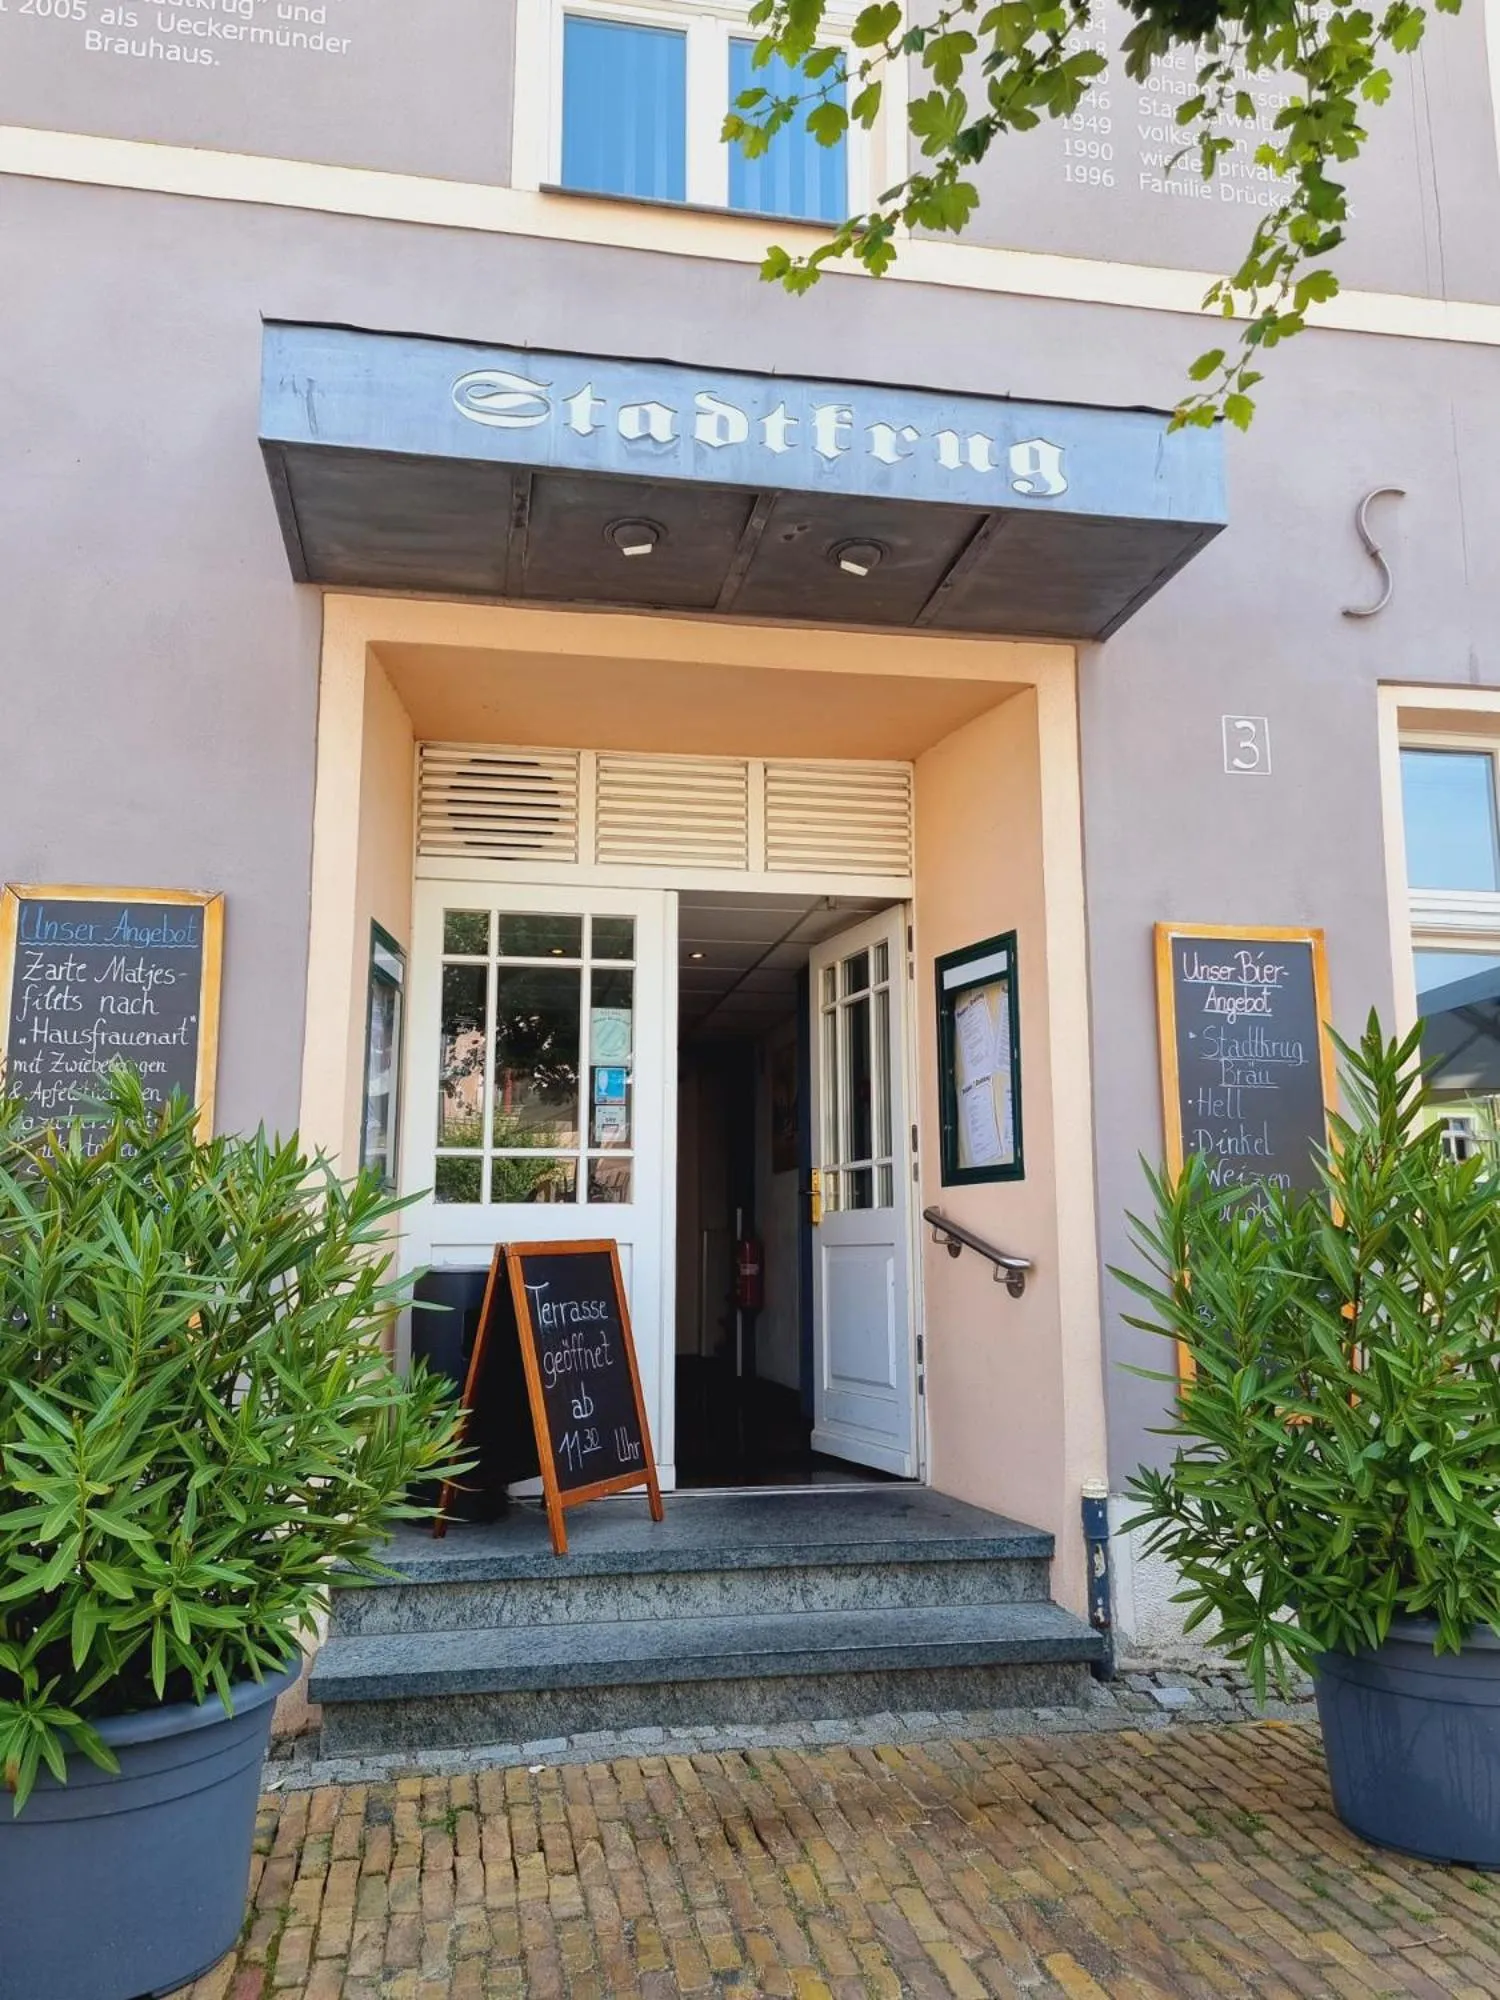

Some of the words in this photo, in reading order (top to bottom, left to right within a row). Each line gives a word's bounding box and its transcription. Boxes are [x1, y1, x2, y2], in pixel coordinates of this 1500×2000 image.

[100, 6, 138, 28] als
[157, 10, 352, 54] Ueckermünder
[277, 3, 327, 24] und
[85, 29, 221, 66] Brauhaus.
[1063, 138, 1114, 161] 1990
[1065, 164, 1115, 188] 1996
[1139, 173, 1212, 200] Familie
[452, 369, 1070, 498] Stadtkrug
[1232, 720, 1260, 769] 3
[20, 906, 102, 942] Unser
[105, 908, 198, 946] Angebot
[22, 951, 87, 983] Zarte
[94, 955, 188, 991] Matjes-
[1183, 951, 1236, 981] Unser
[1234, 950, 1290, 985] Bier-
[16, 984, 84, 1022] filets
[100, 991, 161, 1016] nach
[1203, 985, 1272, 1024] Angebot
[13, 1050, 45, 1074] mit
[1219, 1058, 1272, 1086] Bräu
[1198, 1087, 1246, 1120] Hell
[1192, 1120, 1275, 1157] Dinkel
[524, 1281, 610, 1331] Terrasse
[543, 1331, 614, 1389] geöffnet
[571, 1379, 595, 1420] ab
[614, 1426, 642, 1463] Uhr
